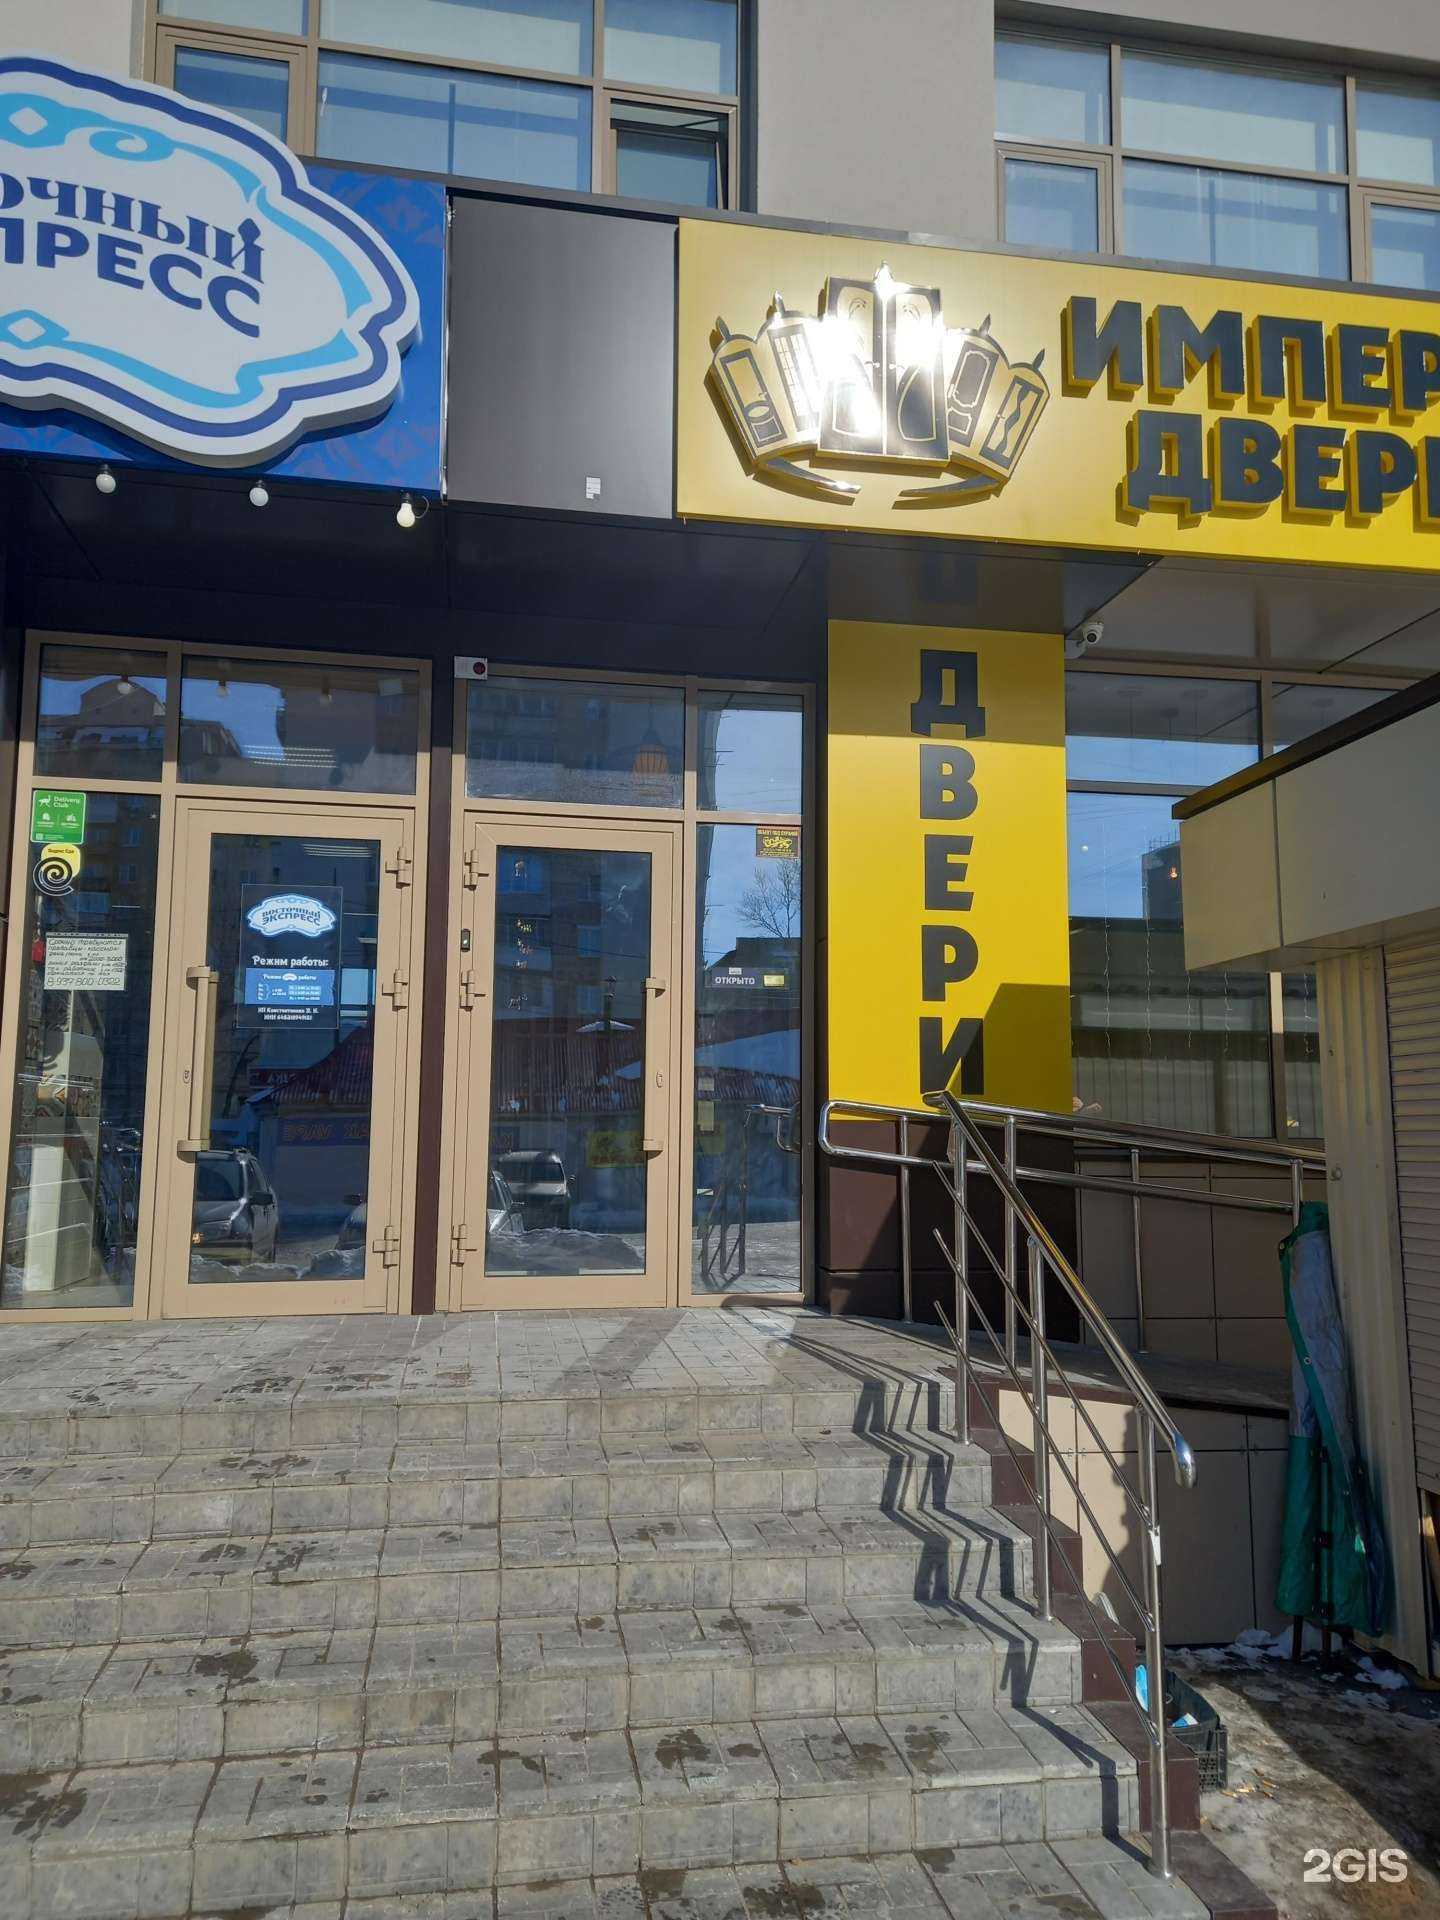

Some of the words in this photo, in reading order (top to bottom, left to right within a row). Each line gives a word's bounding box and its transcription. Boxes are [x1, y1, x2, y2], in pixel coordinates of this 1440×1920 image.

[1067, 296, 1440, 416] ИМПЕР
[1124, 410, 1440, 520] ДВЕР
[53, 796, 80, 805] Delivery
[910, 648, 986, 1096] ДВЕРИ
[262, 913, 321, 926] ЭКСПРЕСС
[252, 955, 288, 966] Режим
[290, 956, 329, 968] работы:
[715, 976, 756, 985] ОТКРЫТО
